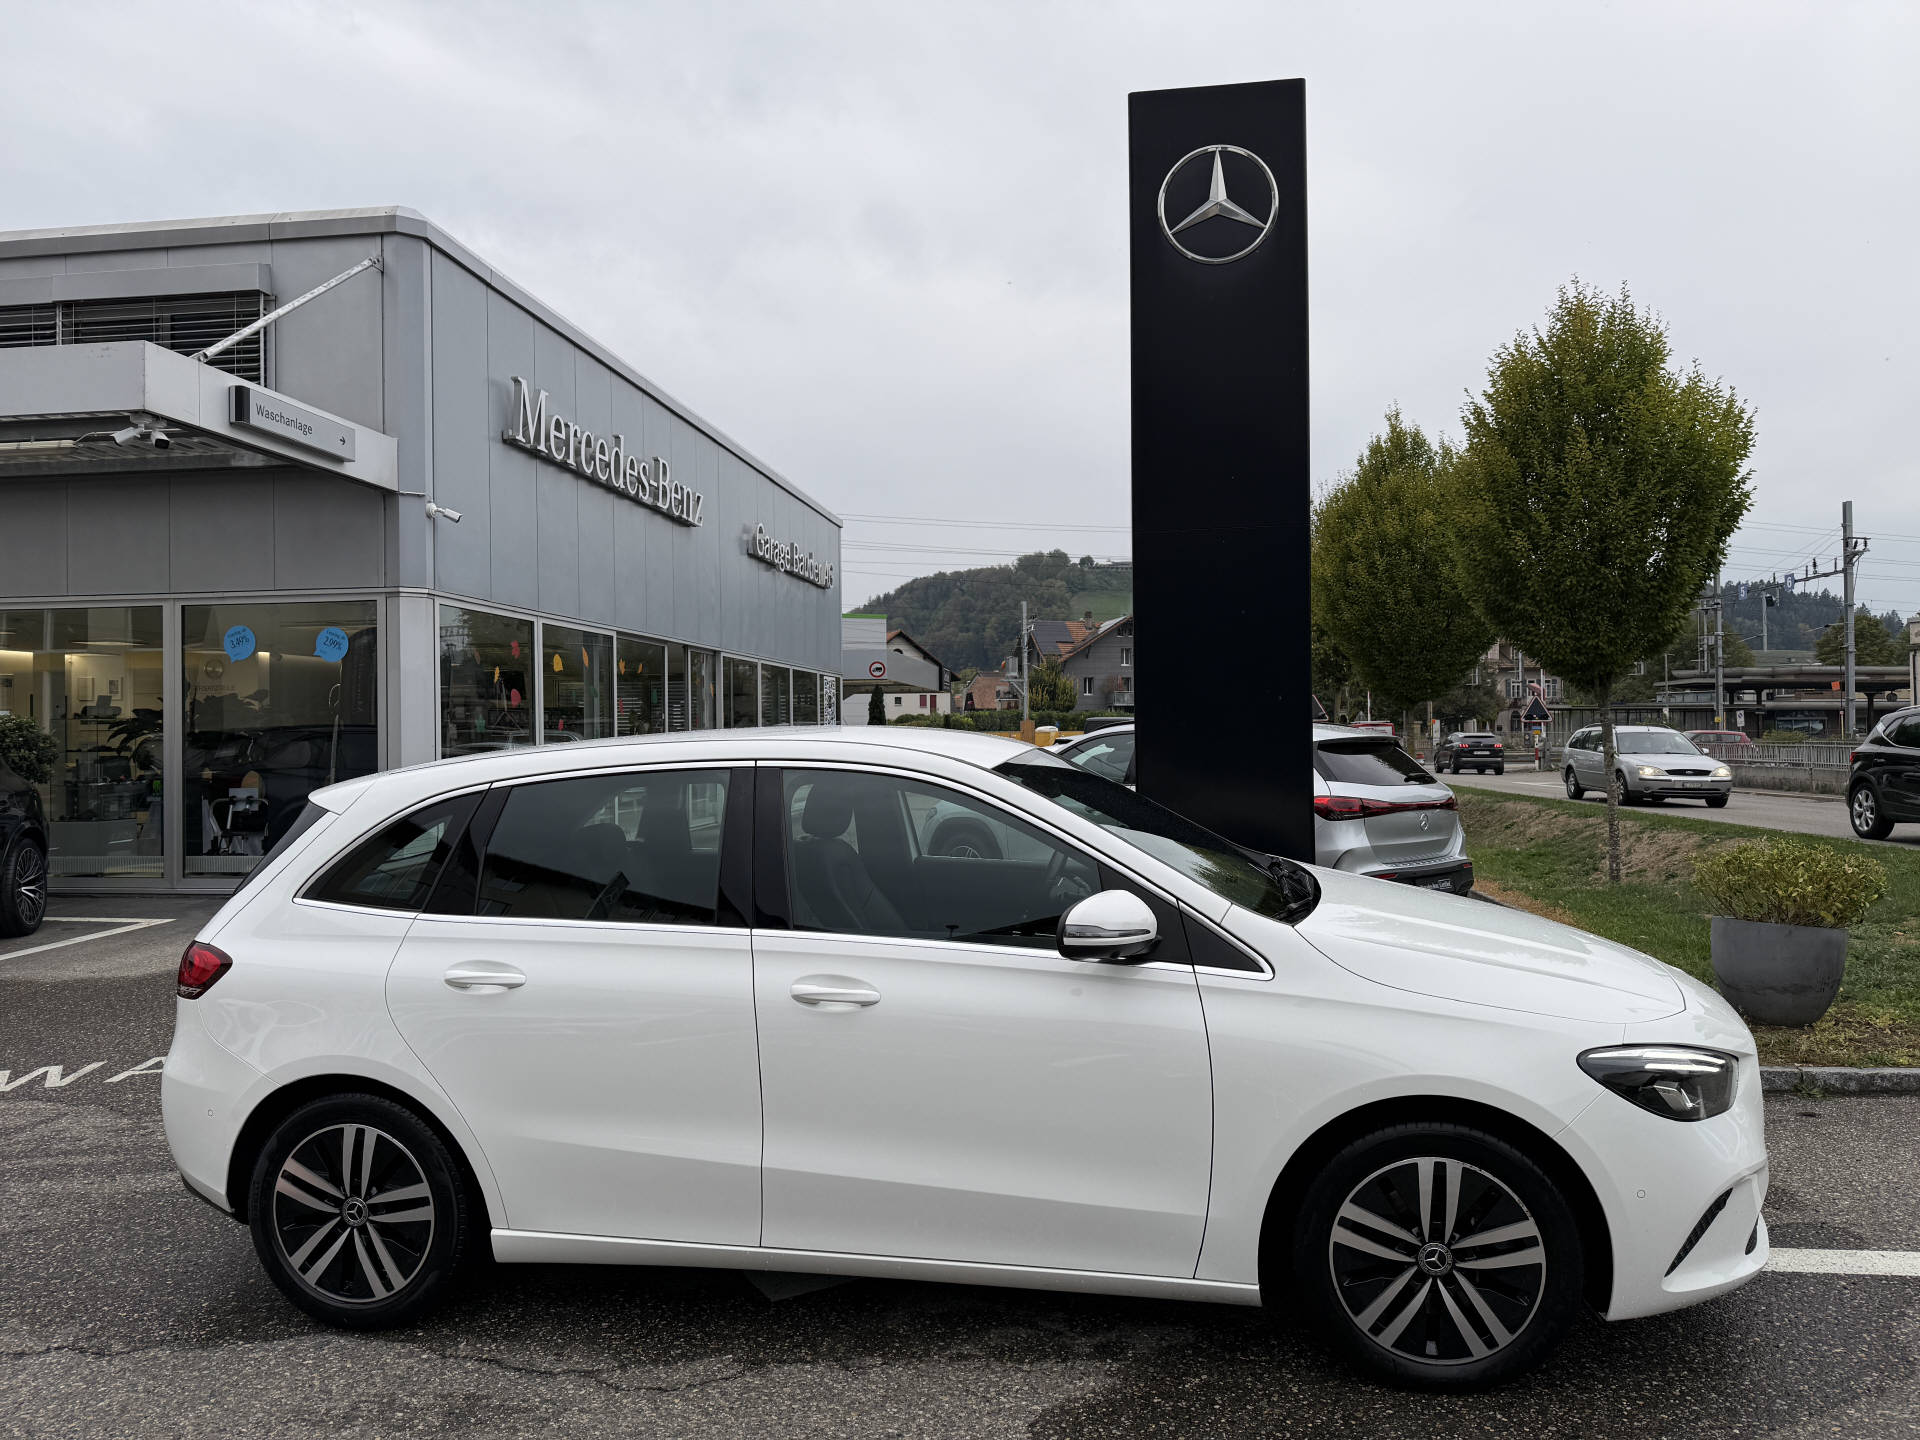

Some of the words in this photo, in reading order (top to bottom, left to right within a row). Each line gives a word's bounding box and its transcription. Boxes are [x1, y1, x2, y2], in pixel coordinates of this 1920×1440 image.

[256, 402, 313, 436] Waschanlage
[511, 376, 704, 527] Mercedes-Benz
[756, 523, 791, 572] Garage
[1740, 585, 1746, 598] 5
[1786, 576, 1793, 588] 6
